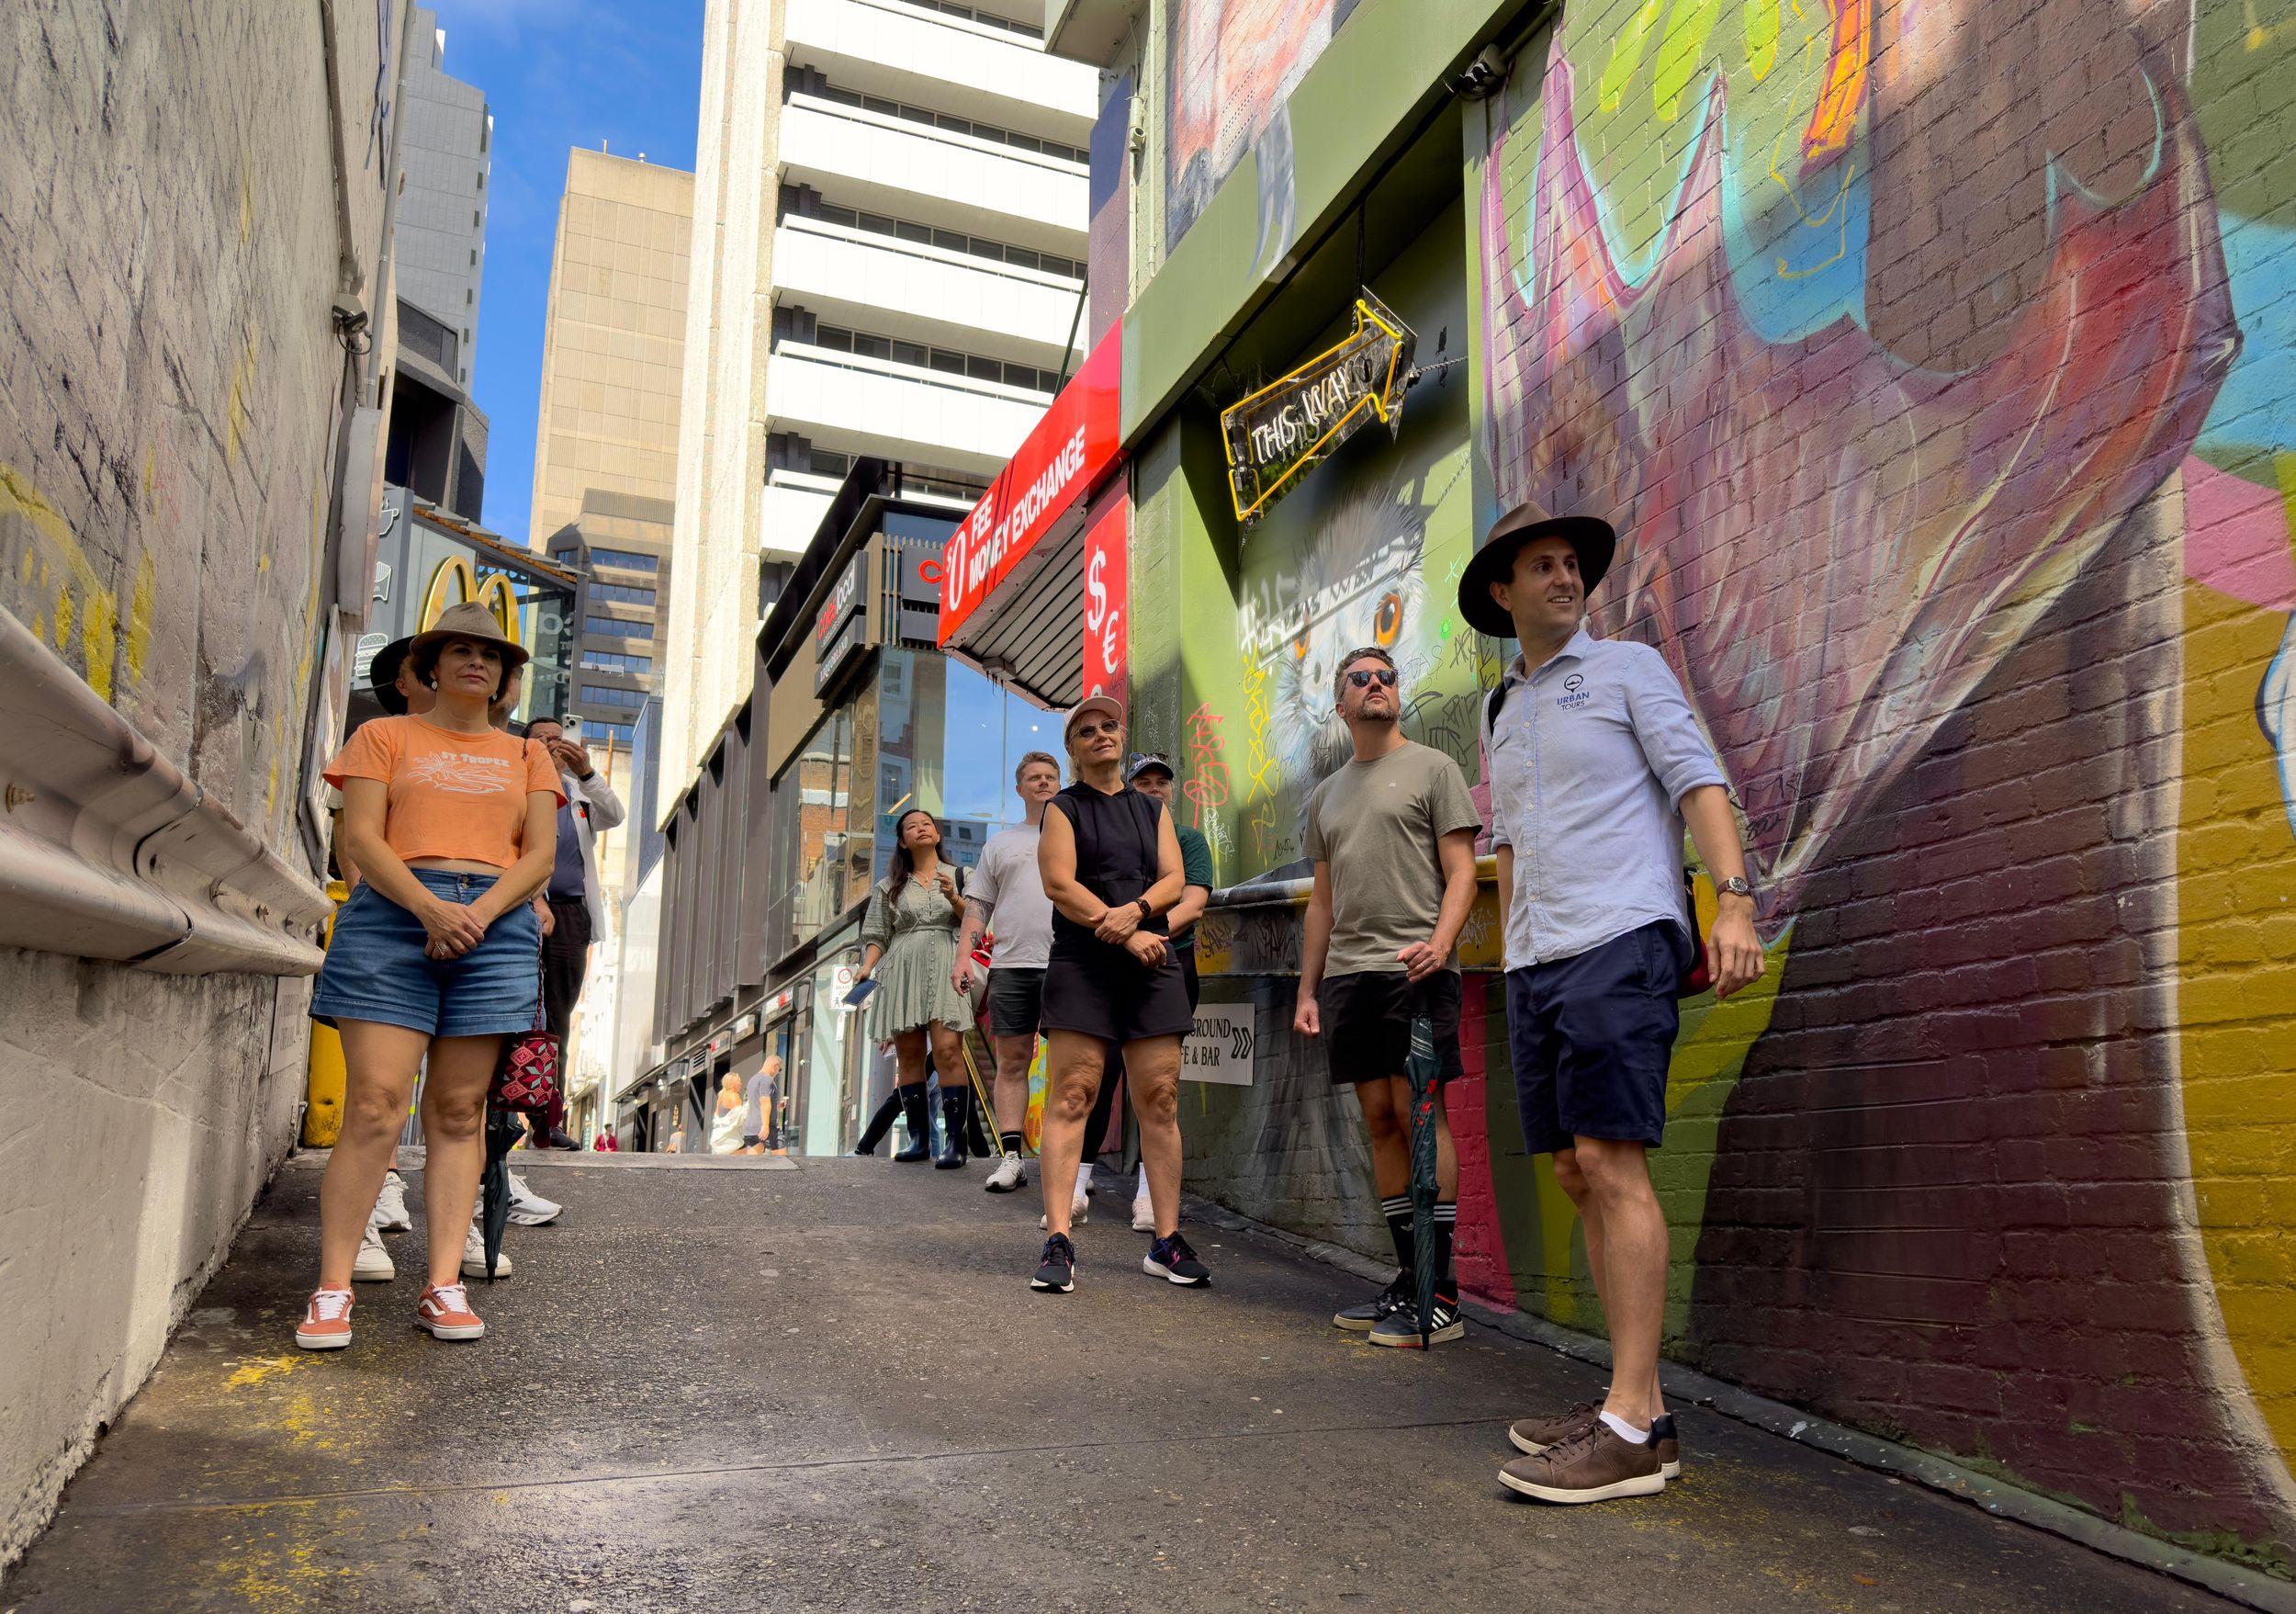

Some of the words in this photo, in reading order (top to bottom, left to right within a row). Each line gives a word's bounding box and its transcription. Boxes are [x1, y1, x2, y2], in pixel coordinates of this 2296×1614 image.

[1252, 405, 1296, 464] THIS
[969, 514, 1011, 593] MONEY
[1012, 423, 1086, 545] EXCHANGE
[971, 492, 993, 547] FEE
[1087, 545, 1107, 637] $
[819, 636, 849, 683] LIQUORLAND
[1102, 610, 1120, 674] €
[1557, 691, 1590, 705] URBAN
[1561, 700, 1585, 712] TOURS
[441, 751, 457, 761] ST
[460, 752, 511, 768] TROPEZ
[1187, 1018, 1232, 1039] GROUND
[1191, 1046, 1199, 1066] &
[1201, 1046, 1221, 1067] BAR
